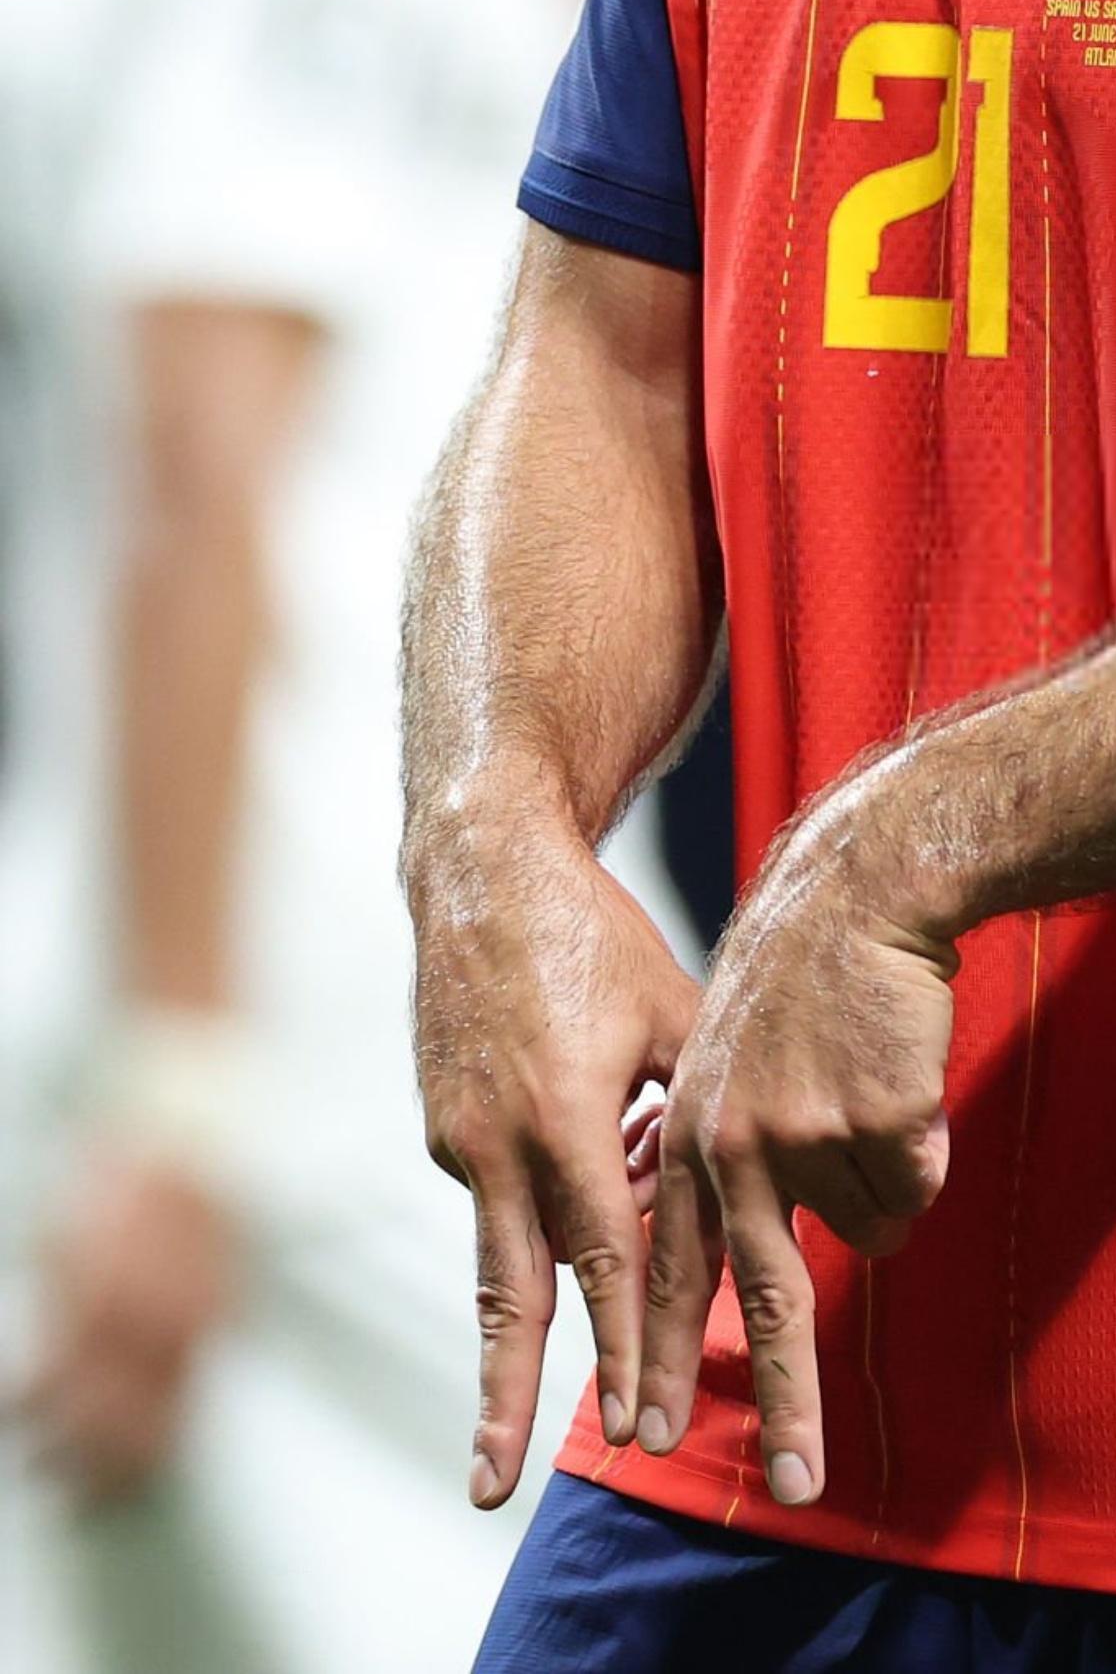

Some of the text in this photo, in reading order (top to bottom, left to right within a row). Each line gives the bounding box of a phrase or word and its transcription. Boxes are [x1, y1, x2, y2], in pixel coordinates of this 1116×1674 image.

[1072, 22, 1086, 41] 21
[1087, 24, 1116, 43] JUNE
[823, 21, 1013, 358] 21
